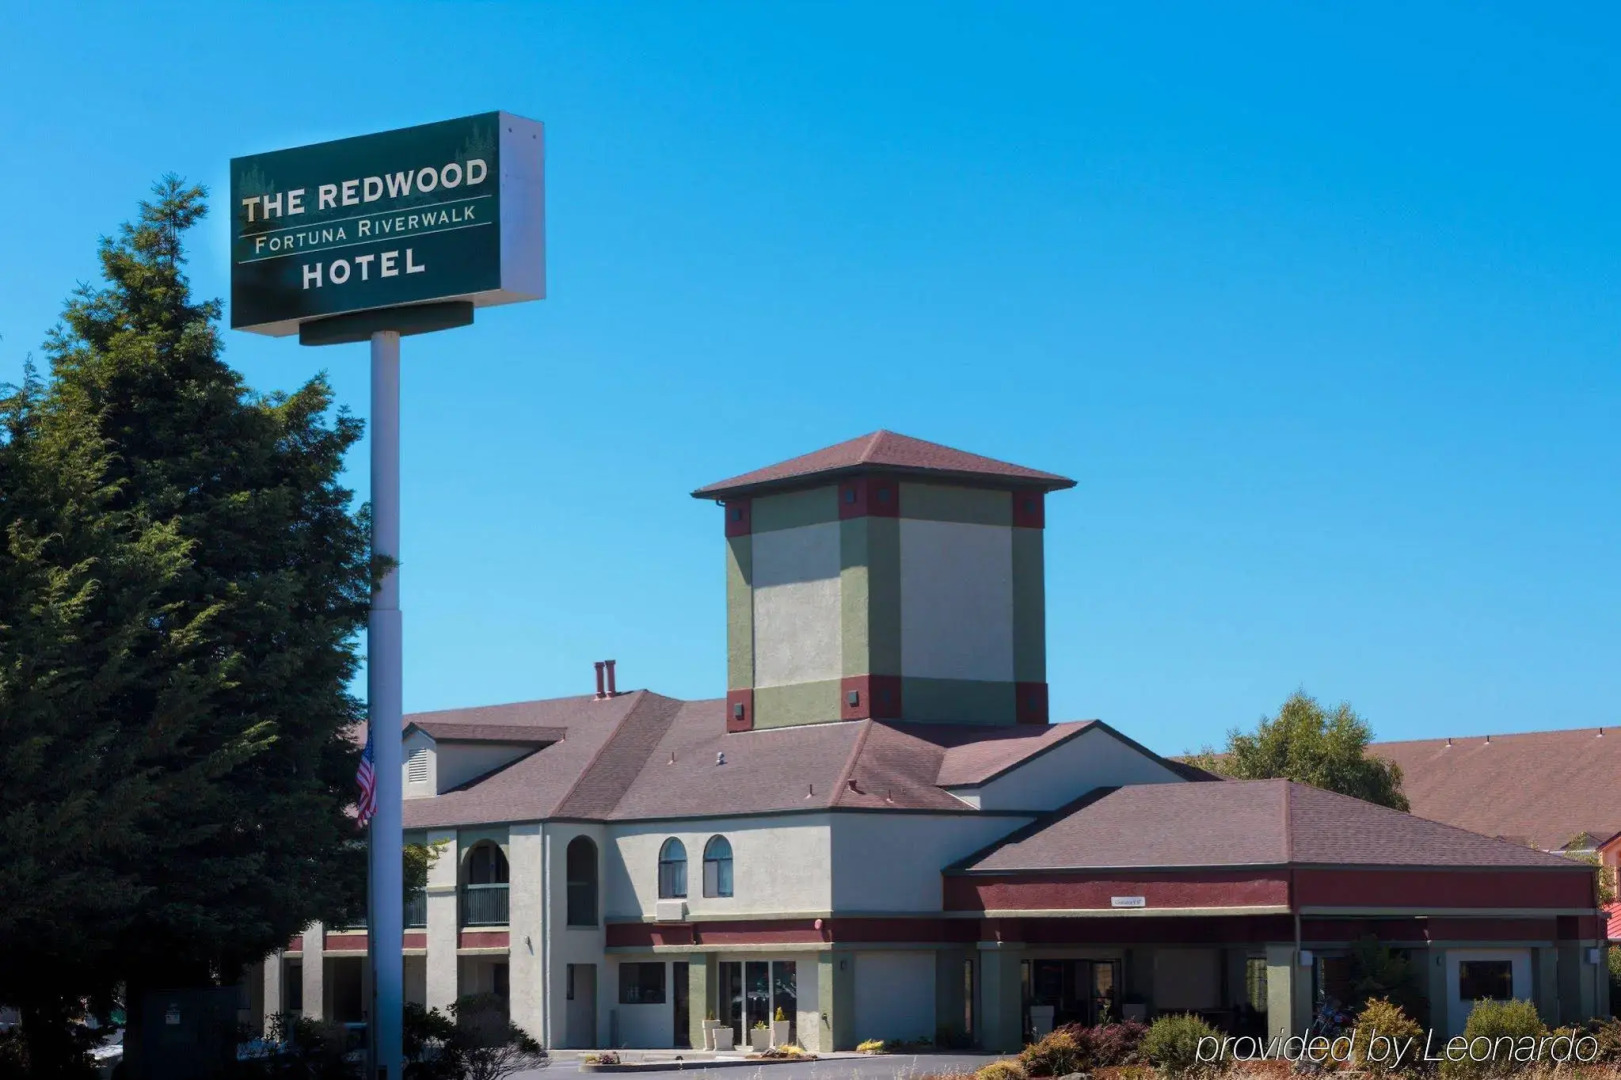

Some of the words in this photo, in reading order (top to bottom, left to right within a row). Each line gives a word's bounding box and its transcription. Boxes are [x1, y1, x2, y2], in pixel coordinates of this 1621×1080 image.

[242, 188, 305, 222] THE
[318, 158, 488, 210] REDWOOD
[255, 226, 346, 254] FORTUNA
[358, 206, 476, 237] RIVERWALK
[302, 248, 426, 289] HOTEL
